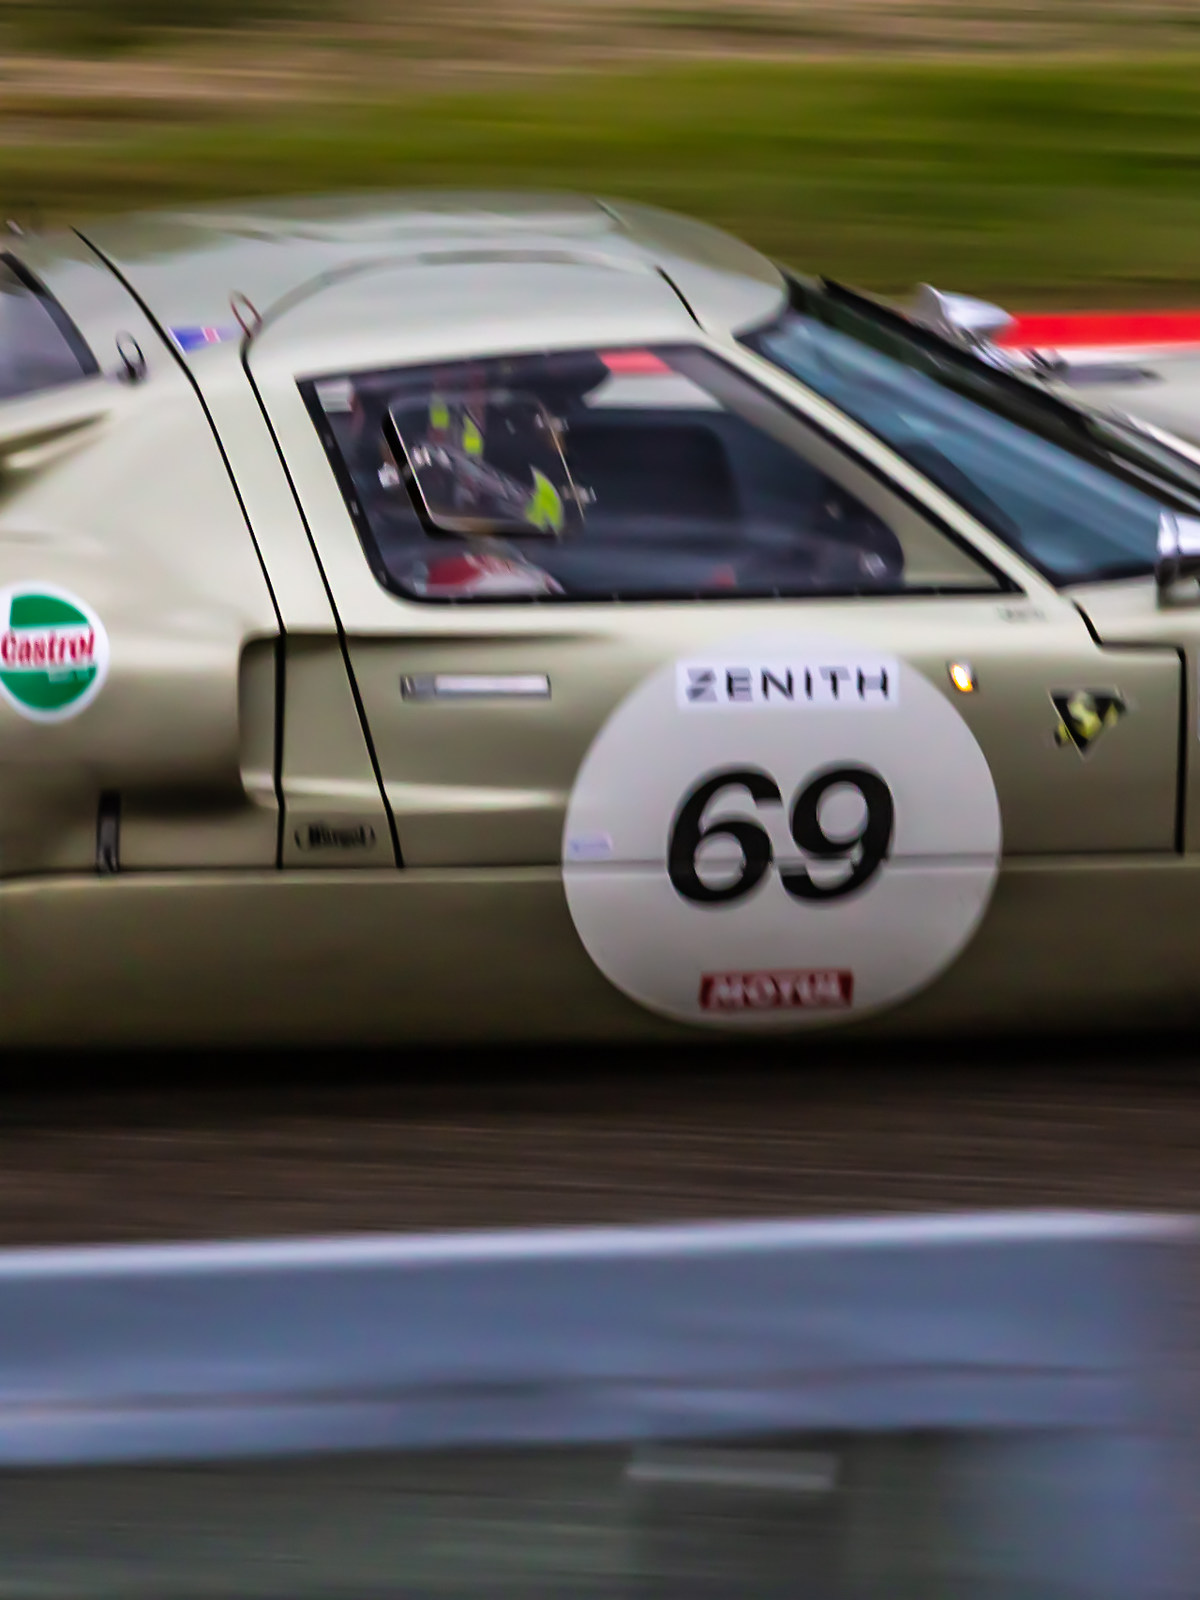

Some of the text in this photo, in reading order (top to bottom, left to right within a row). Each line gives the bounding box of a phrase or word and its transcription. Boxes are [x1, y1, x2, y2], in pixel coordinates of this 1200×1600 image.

[1, 628, 95, 667] Castrol
[684, 666, 890, 701] ZENITH
[666, 761, 894, 908] 69
[711, 973, 843, 1007] MOTUL
